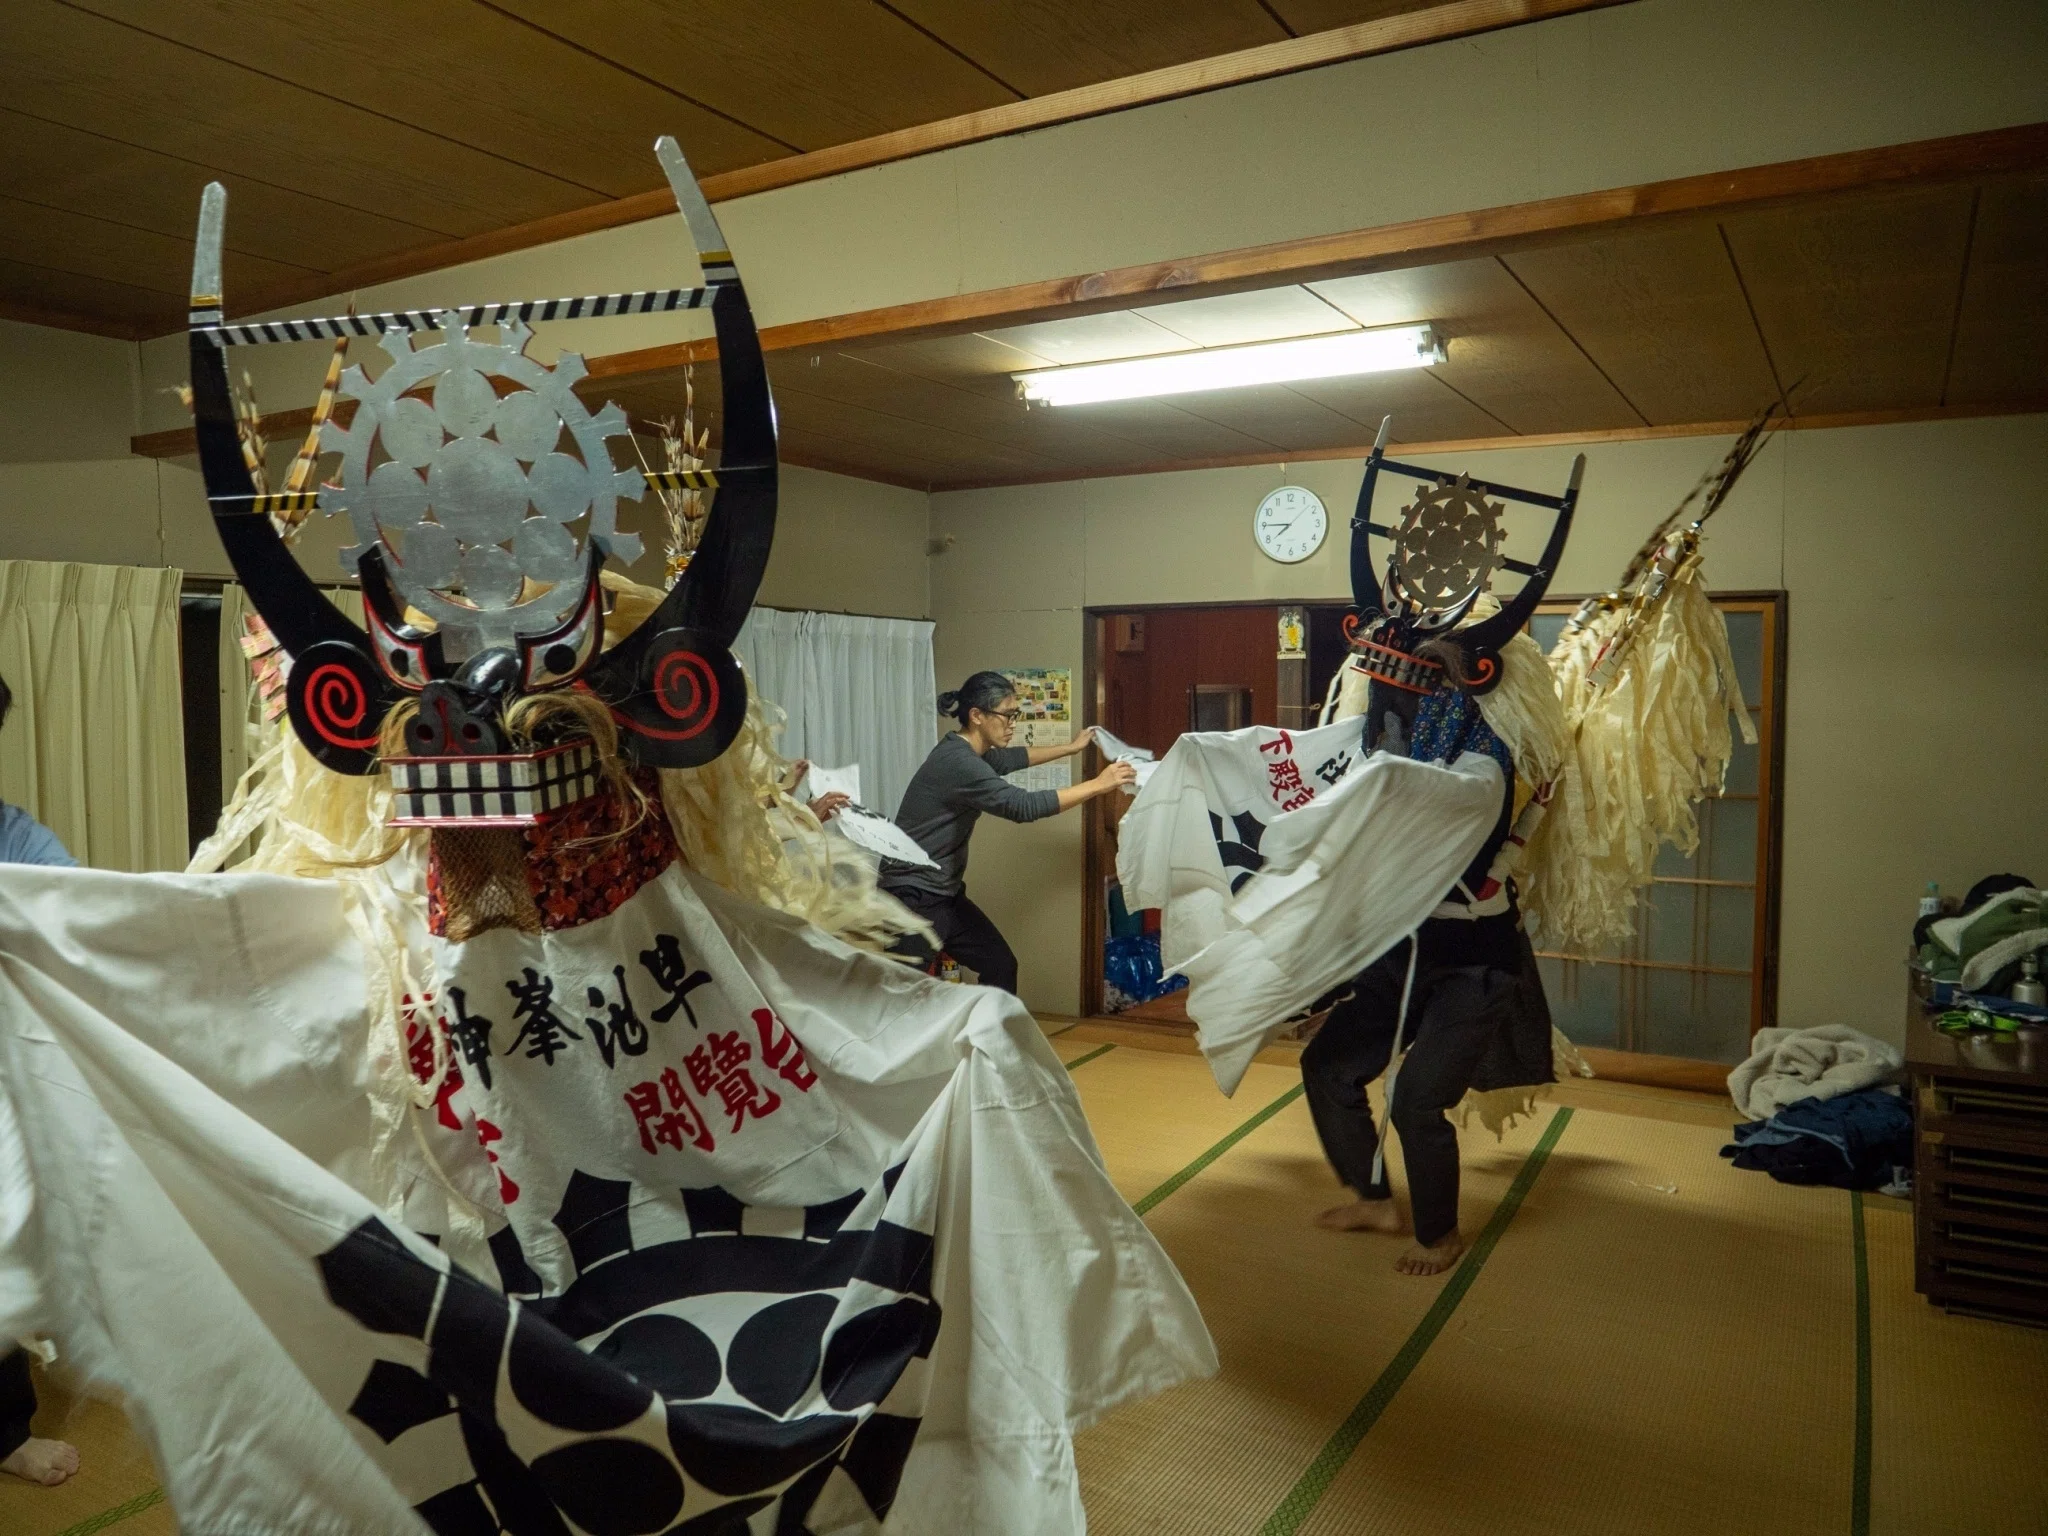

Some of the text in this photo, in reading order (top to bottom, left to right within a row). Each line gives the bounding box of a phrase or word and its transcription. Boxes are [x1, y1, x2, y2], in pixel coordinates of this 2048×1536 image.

[1275, 497, 1281, 507] 11
[1286, 493, 1295, 503] 12
[1302, 496, 1306, 505] 1
[1265, 507, 1273, 517] 10
[1311, 505, 1317, 515] 2
[1261, 521, 1268, 531] 9
[1315, 518, 1321, 528] 3
[1265, 534, 1272, 544] 8
[1311, 533, 1317, 542] 4
[1276, 544, 1282, 553] 7
[1288, 546, 1294, 556] 6
[1301, 542, 1307, 552] 5
